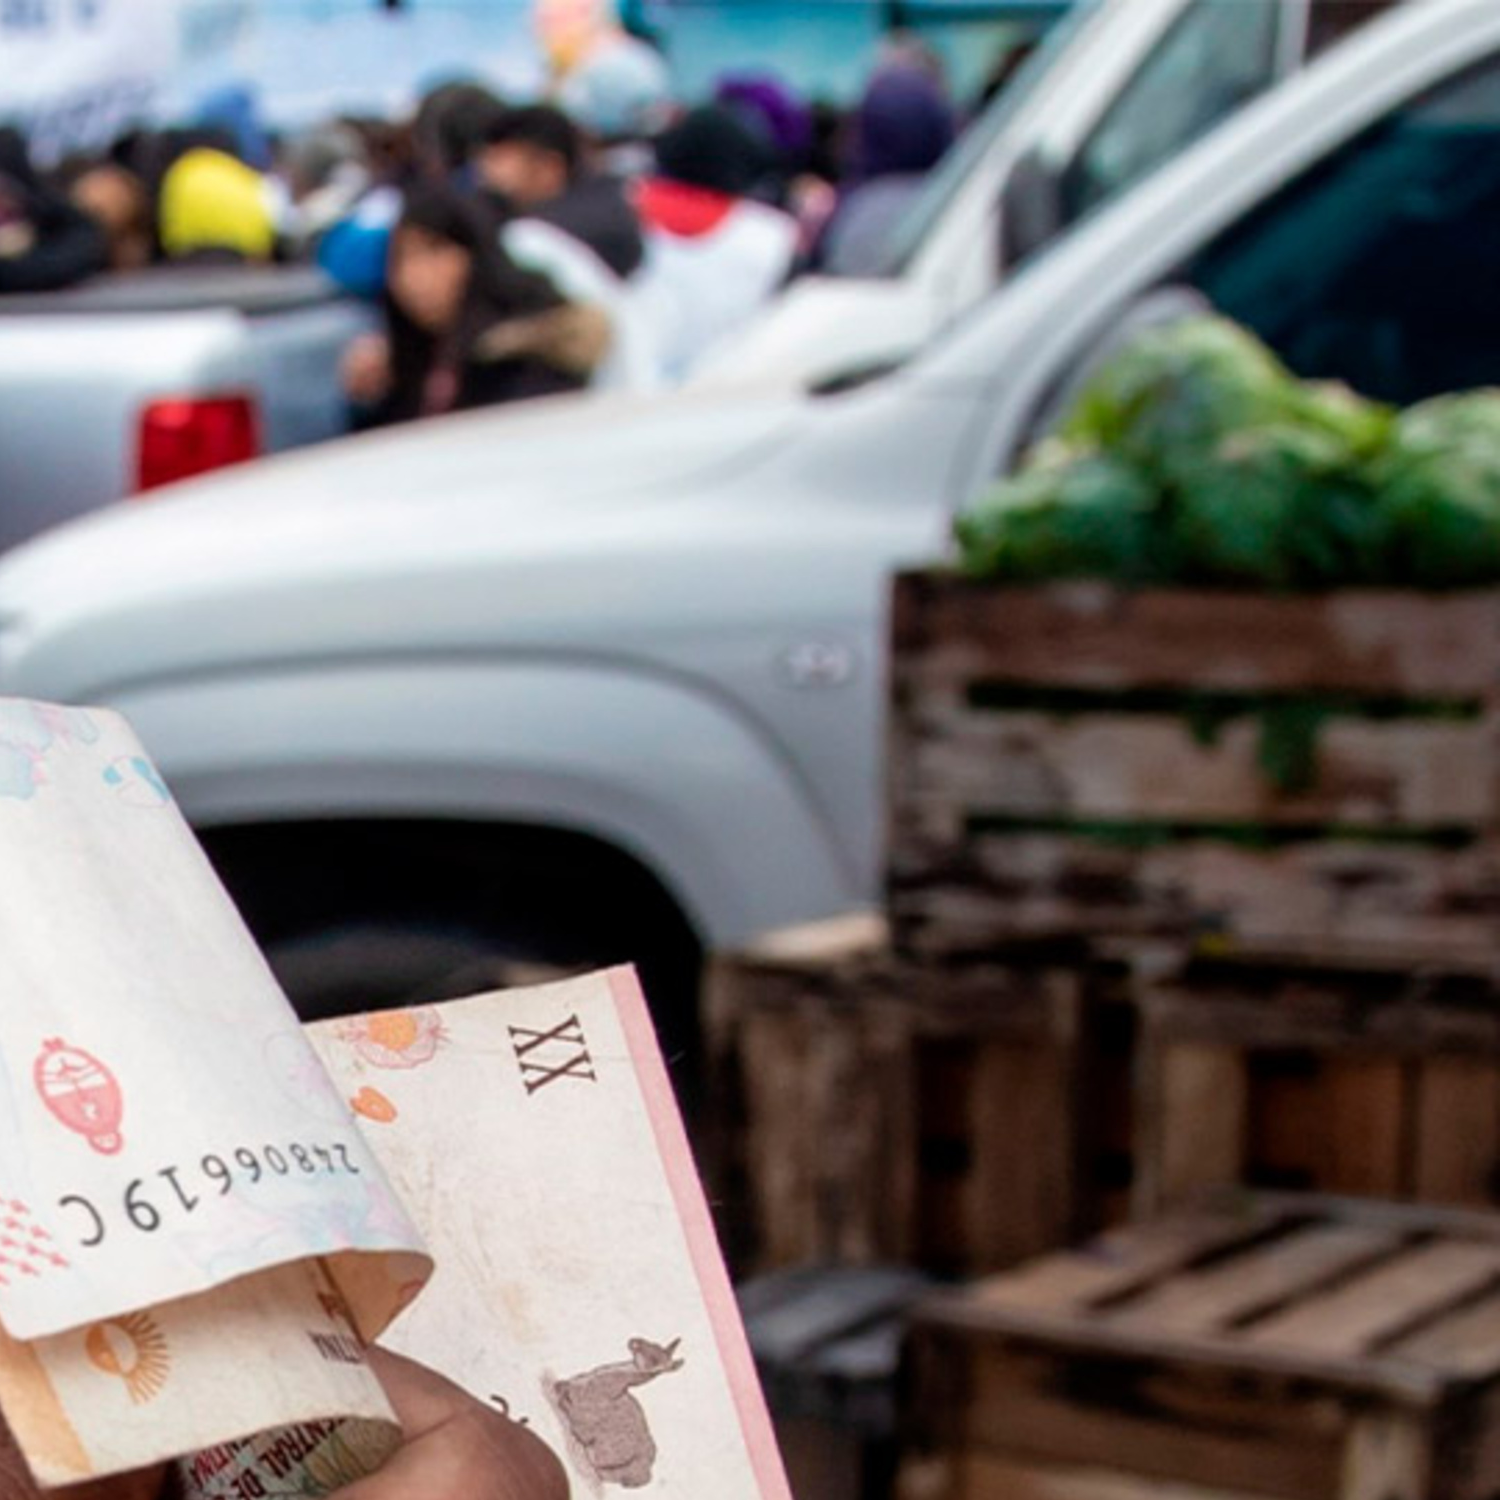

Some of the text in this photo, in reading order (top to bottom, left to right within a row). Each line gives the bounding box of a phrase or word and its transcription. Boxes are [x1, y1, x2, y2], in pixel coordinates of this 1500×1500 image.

[507, 1013, 597, 1096] XX
[58, 1142, 360, 1248] 24806619 C
[189, 1434, 257, 1491] NTINA
[258, 1418, 347, 1480] NTRAL
